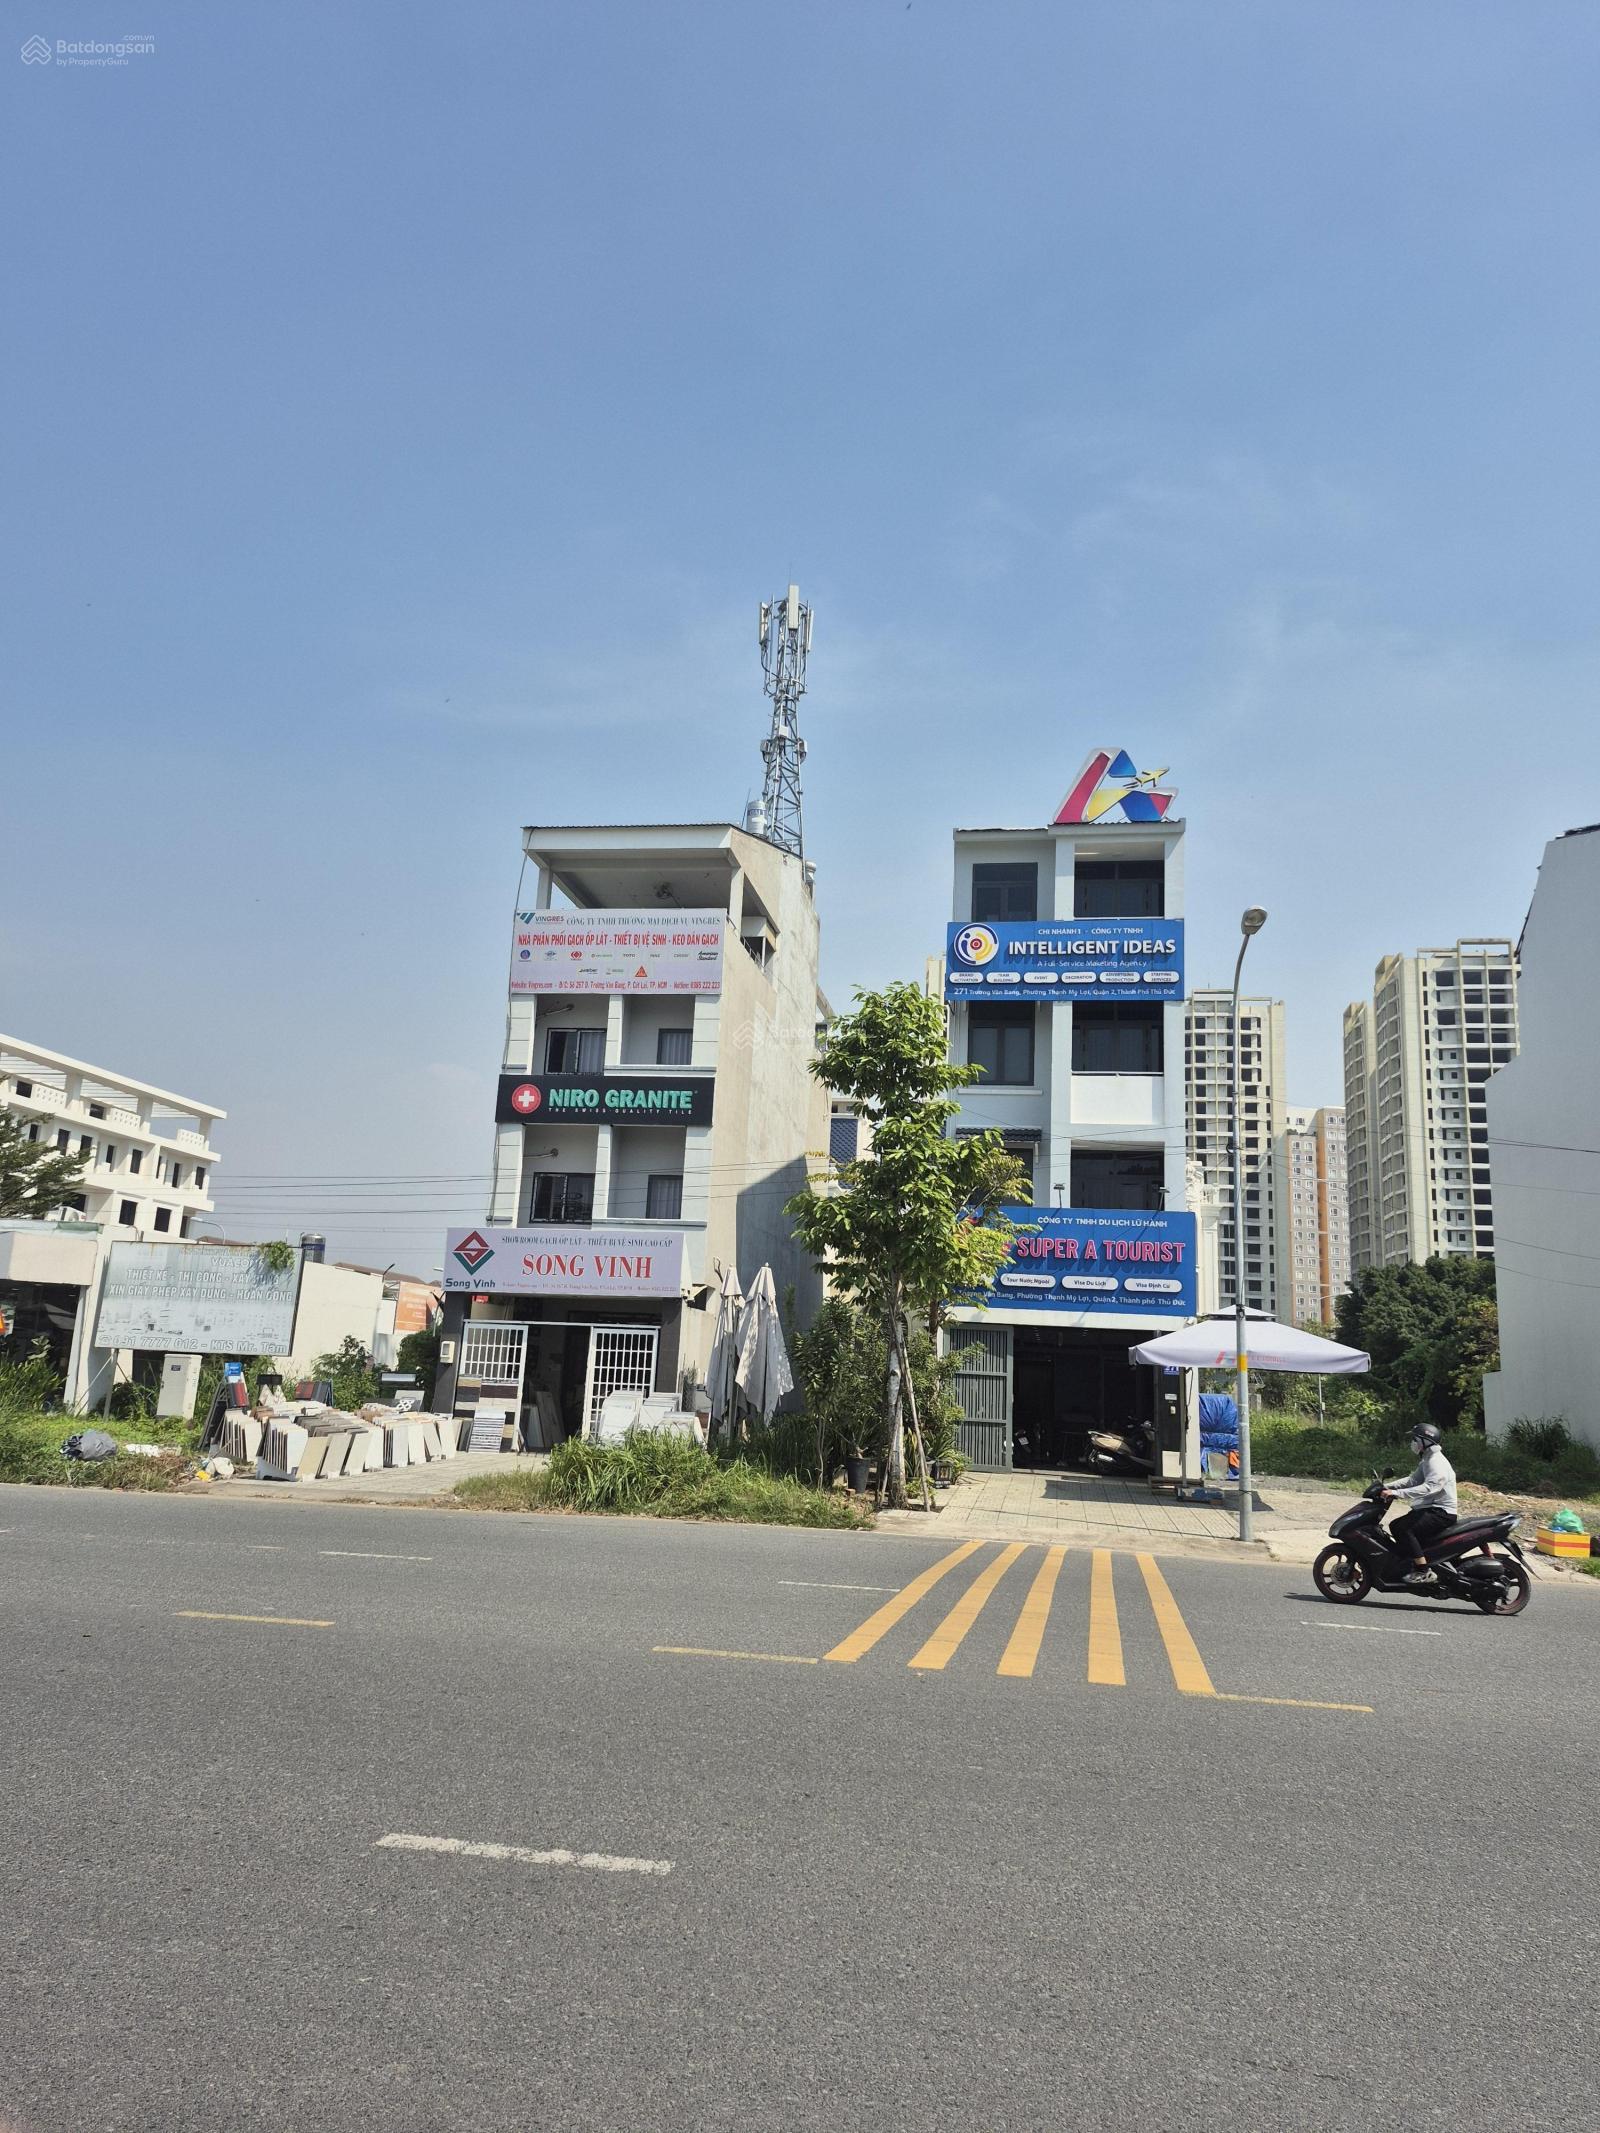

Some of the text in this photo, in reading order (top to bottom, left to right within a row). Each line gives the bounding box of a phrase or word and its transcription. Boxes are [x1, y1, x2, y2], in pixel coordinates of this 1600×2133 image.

[587, 917, 594, 926] TY
[691, 916, 720, 926] VINGRES
[1091, 926, 1111, 935] CÔNG
[567, 934, 584, 949] GẠCH
[614, 929, 632, 946] THIẾT
[651, 934, 667, 945] SINH
[672, 934, 685, 945] KEO
[701, 934, 719, 948] GẠCH
[1008, 939, 1176, 955] INTELLIGENT IDEAS
[1119, 960, 1147, 968] Agency
[954, 987, 968, 995] 271
[549, 1088, 692, 1109] NIRO GRANITE
[1037, 1215, 1061, 1224] CÔNG
[1063, 1217, 1073, 1225] TY
[1112, 1219, 1130, 1227] LỊCH
[1144, 1217, 1168, 1228] HÀNH
[628, 1239, 643, 1248] SINH
[645, 1239, 658, 1248] CAO
[1017, 1237, 1186, 1263] SUPER A TOURIST
[522, 1253, 653, 1279] SONG VINH
[109, 1283, 126, 1295] XIN
[445, 1278, 471, 1289] Song
[473, 1279, 496, 1289] Vinh
[1172, 1297, 1187, 1306] Đức
[141, 1336, 172, 1349] 7777
[210, 1339, 234, 1352] KTS
[236, 1340, 258, 1353] Mr.
[261, 1341, 287, 1355] Tâm
